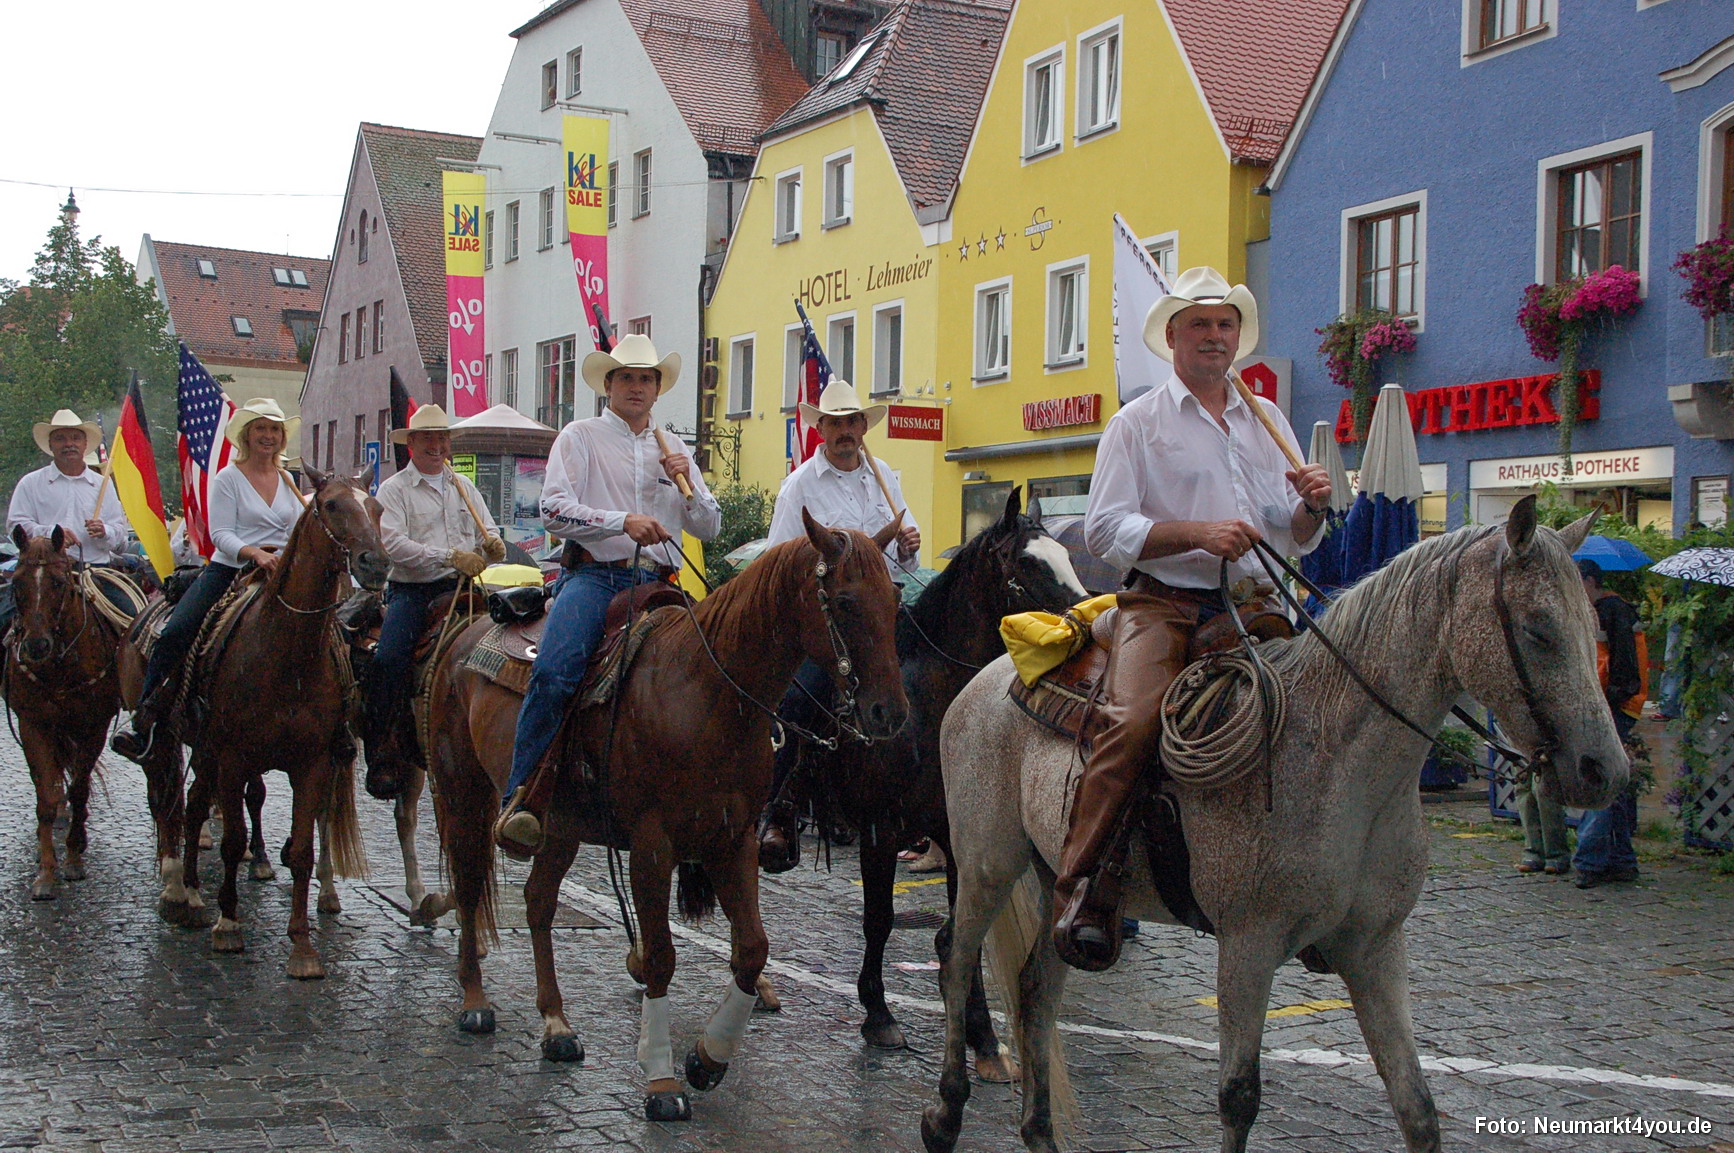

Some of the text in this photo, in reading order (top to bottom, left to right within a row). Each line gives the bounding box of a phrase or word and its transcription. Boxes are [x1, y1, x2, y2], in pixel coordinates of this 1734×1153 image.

[568, 151, 603, 190] K&L
[568, 189, 602, 208] SALE
[800, 253, 933, 309] HOTEL Lehmeier
[891, 415, 940, 431] WISSMACH
[1022, 393, 1097, 431] WISSMACH
[1499, 456, 1641, 480] RATHAUS POTHEKE
[503, 464, 512, 525] STADTMUSEUM
